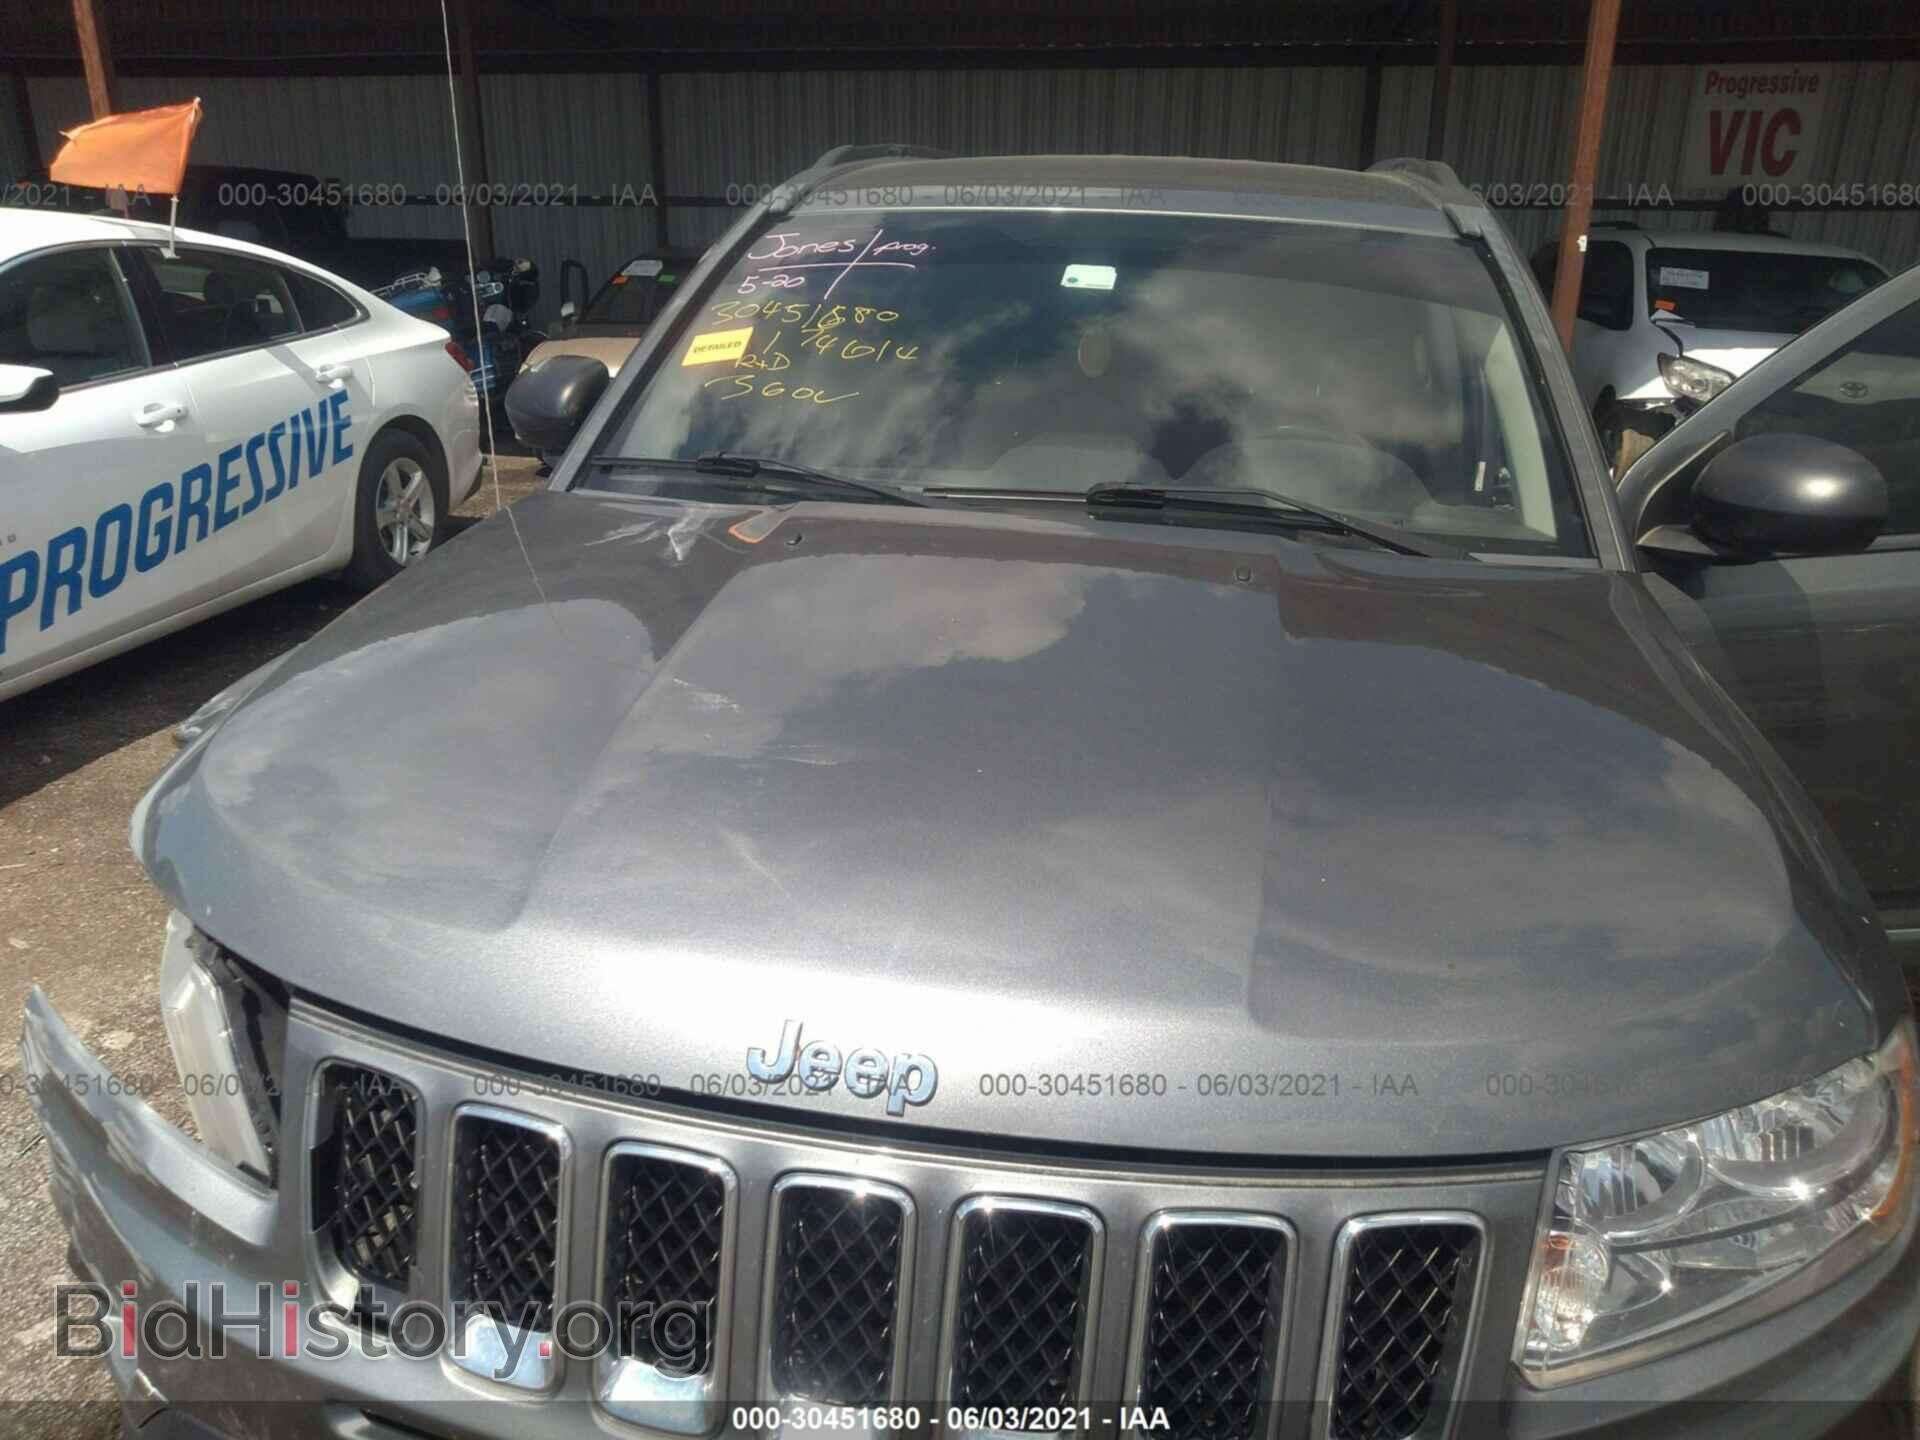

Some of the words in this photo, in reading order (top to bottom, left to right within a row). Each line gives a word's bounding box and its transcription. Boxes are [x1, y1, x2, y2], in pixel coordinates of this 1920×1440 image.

[1705, 68, 1820, 99] Progressive
[1709, 108, 1804, 177] VIC
[0, 388, 354, 657] PROGRESSIVE
[746, 1019, 939, 1117] Jeep
